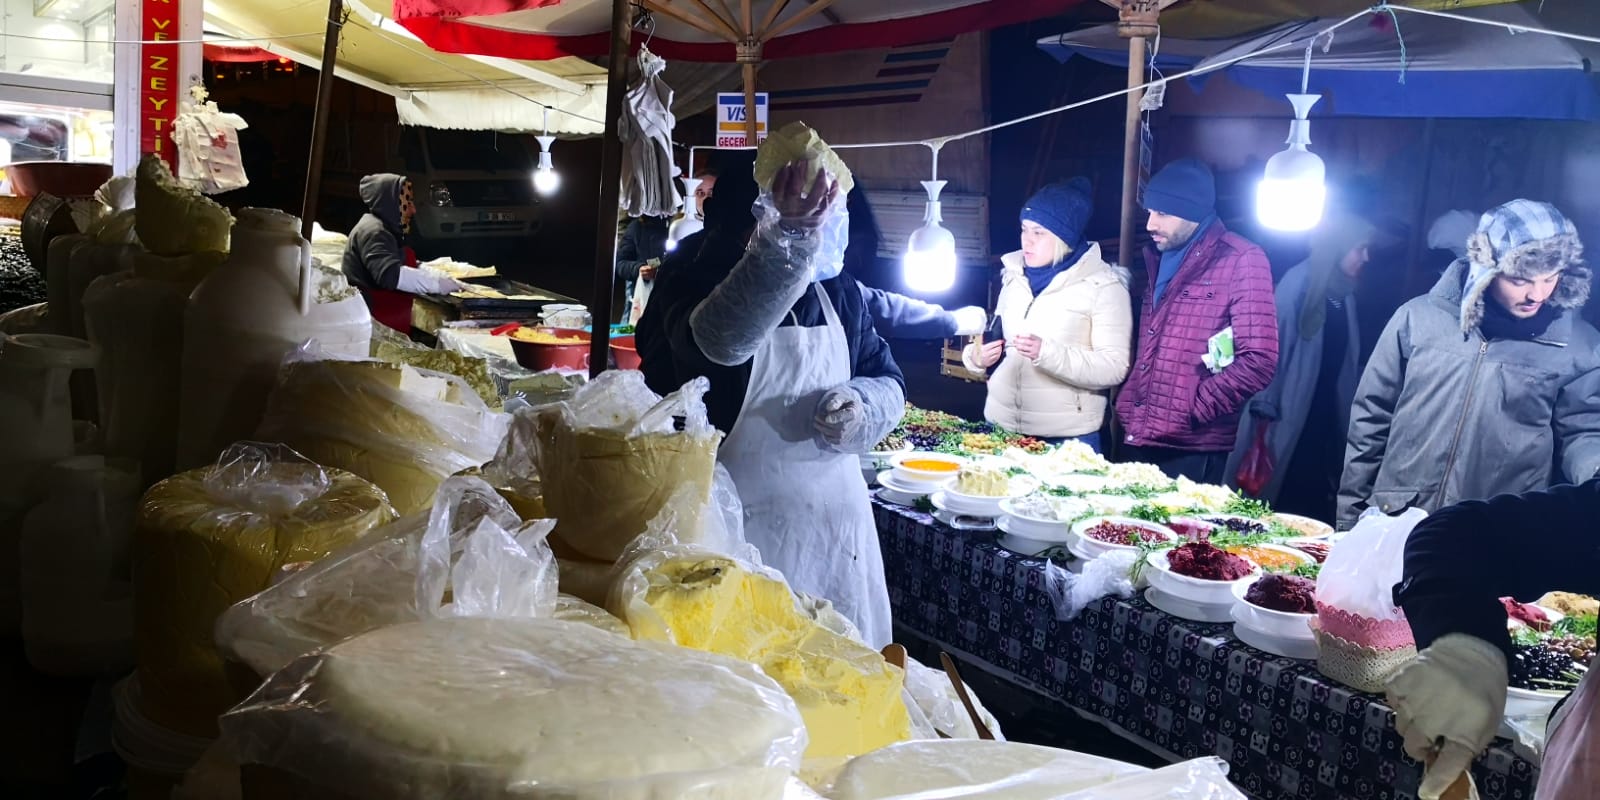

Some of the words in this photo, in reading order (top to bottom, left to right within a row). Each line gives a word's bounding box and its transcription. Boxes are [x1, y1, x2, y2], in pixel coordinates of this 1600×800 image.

[152, 17, 170, 42] VE
[149, 56, 168, 151] ZEYTİ
[727, 106, 747, 121] VIS
